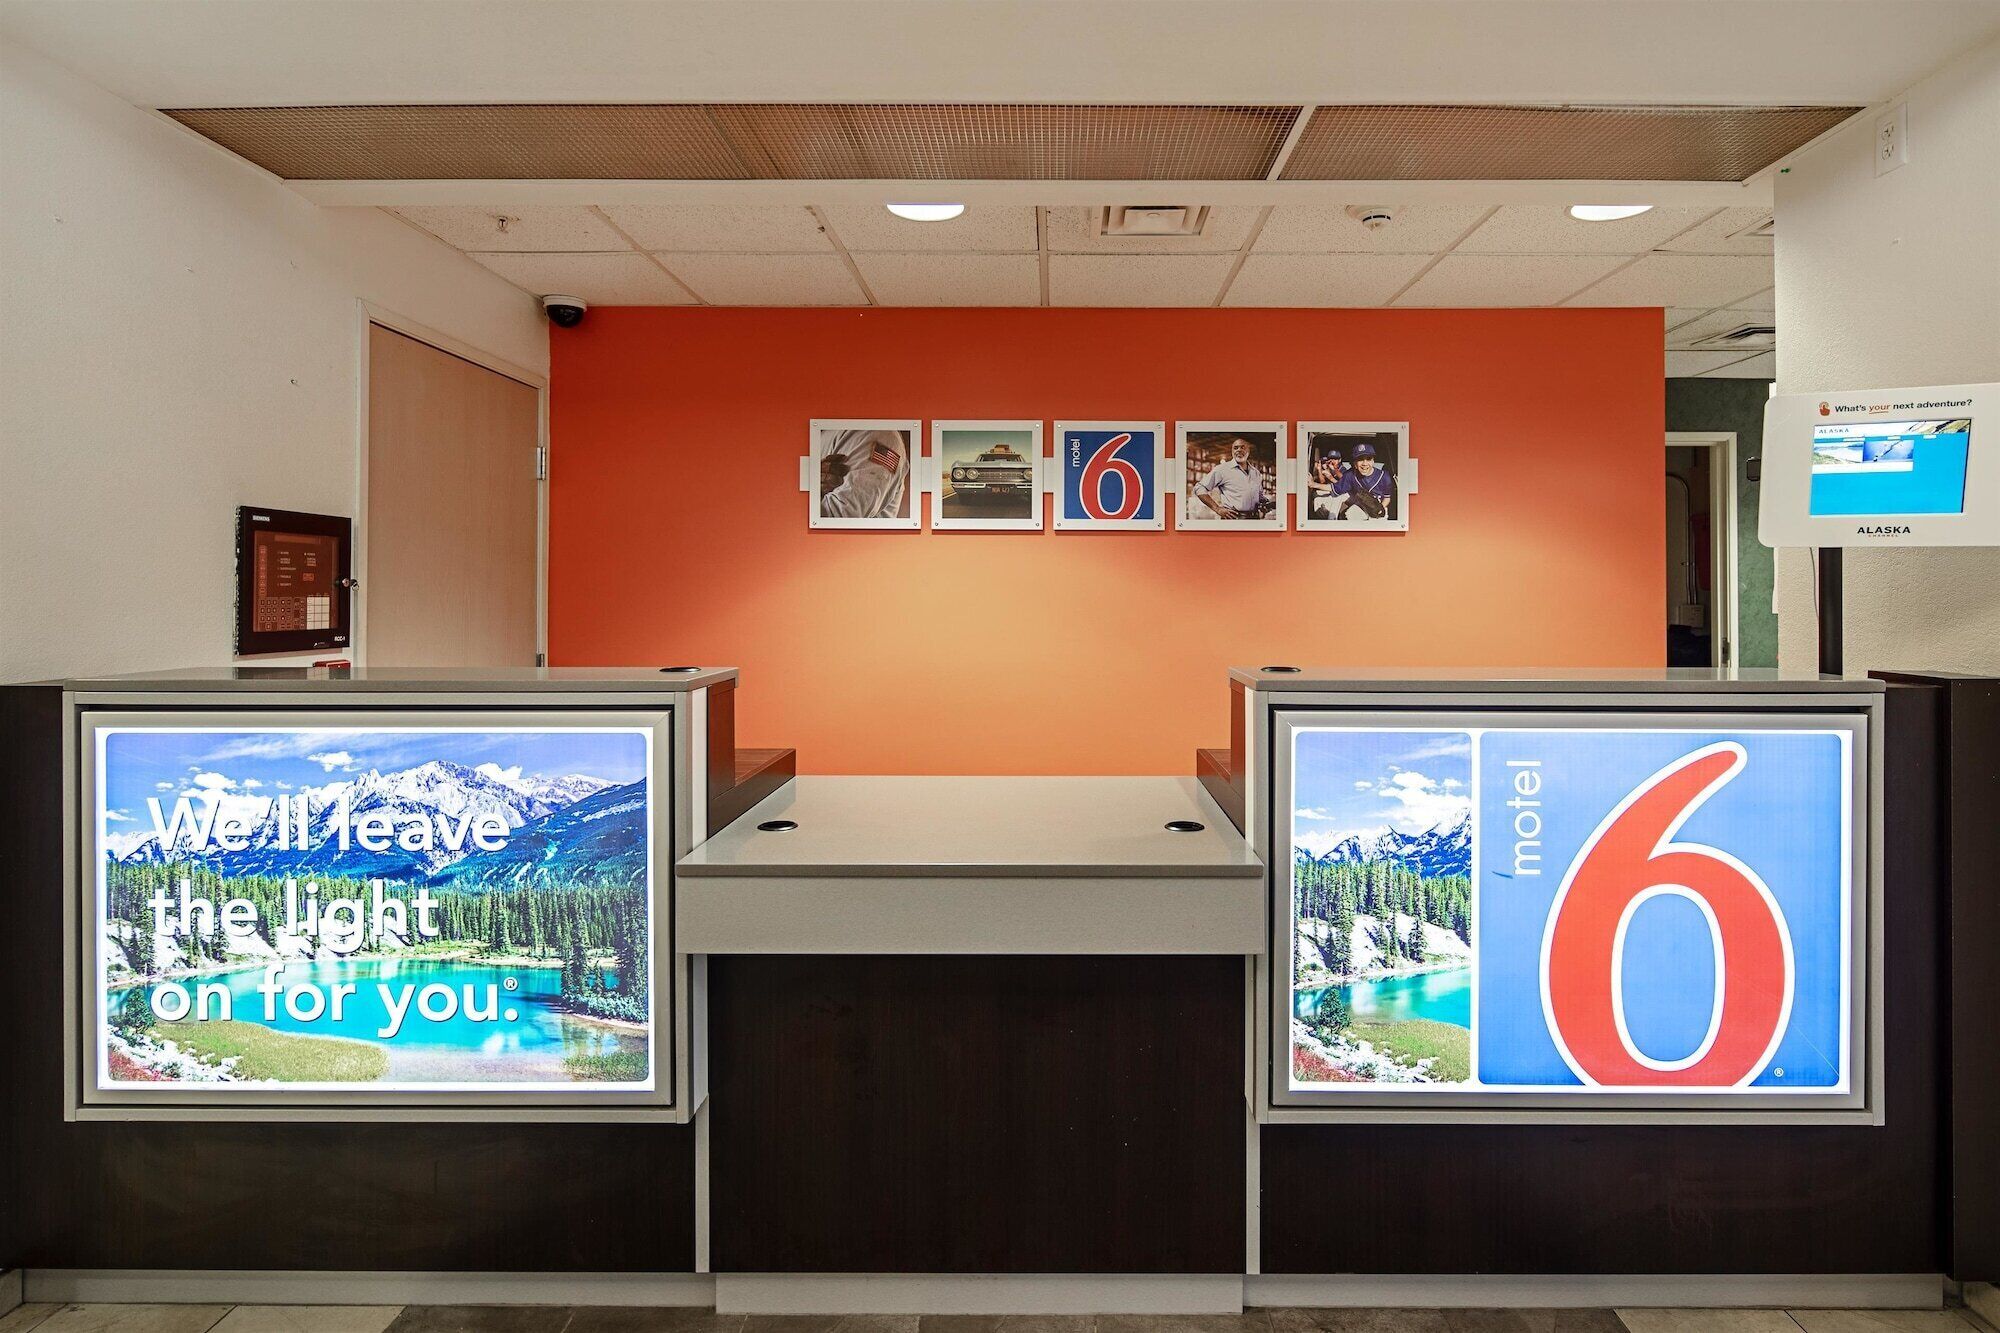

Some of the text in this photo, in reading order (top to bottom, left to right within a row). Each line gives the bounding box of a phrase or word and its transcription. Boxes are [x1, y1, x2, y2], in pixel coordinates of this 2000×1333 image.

[1834, 399, 1973, 414] What's your next adventure?
[1070, 438, 1081, 468] motel
[1079, 432, 1144, 520] 6
[1857, 526, 1911, 534] ALASKA
[148, 794, 512, 853] We'll leave
[1505, 760, 1542, 876] motel
[151, 878, 440, 955] the light
[1539, 740, 1796, 1087] 6
[150, 980, 232, 1022] on
[256, 963, 357, 1022] for
